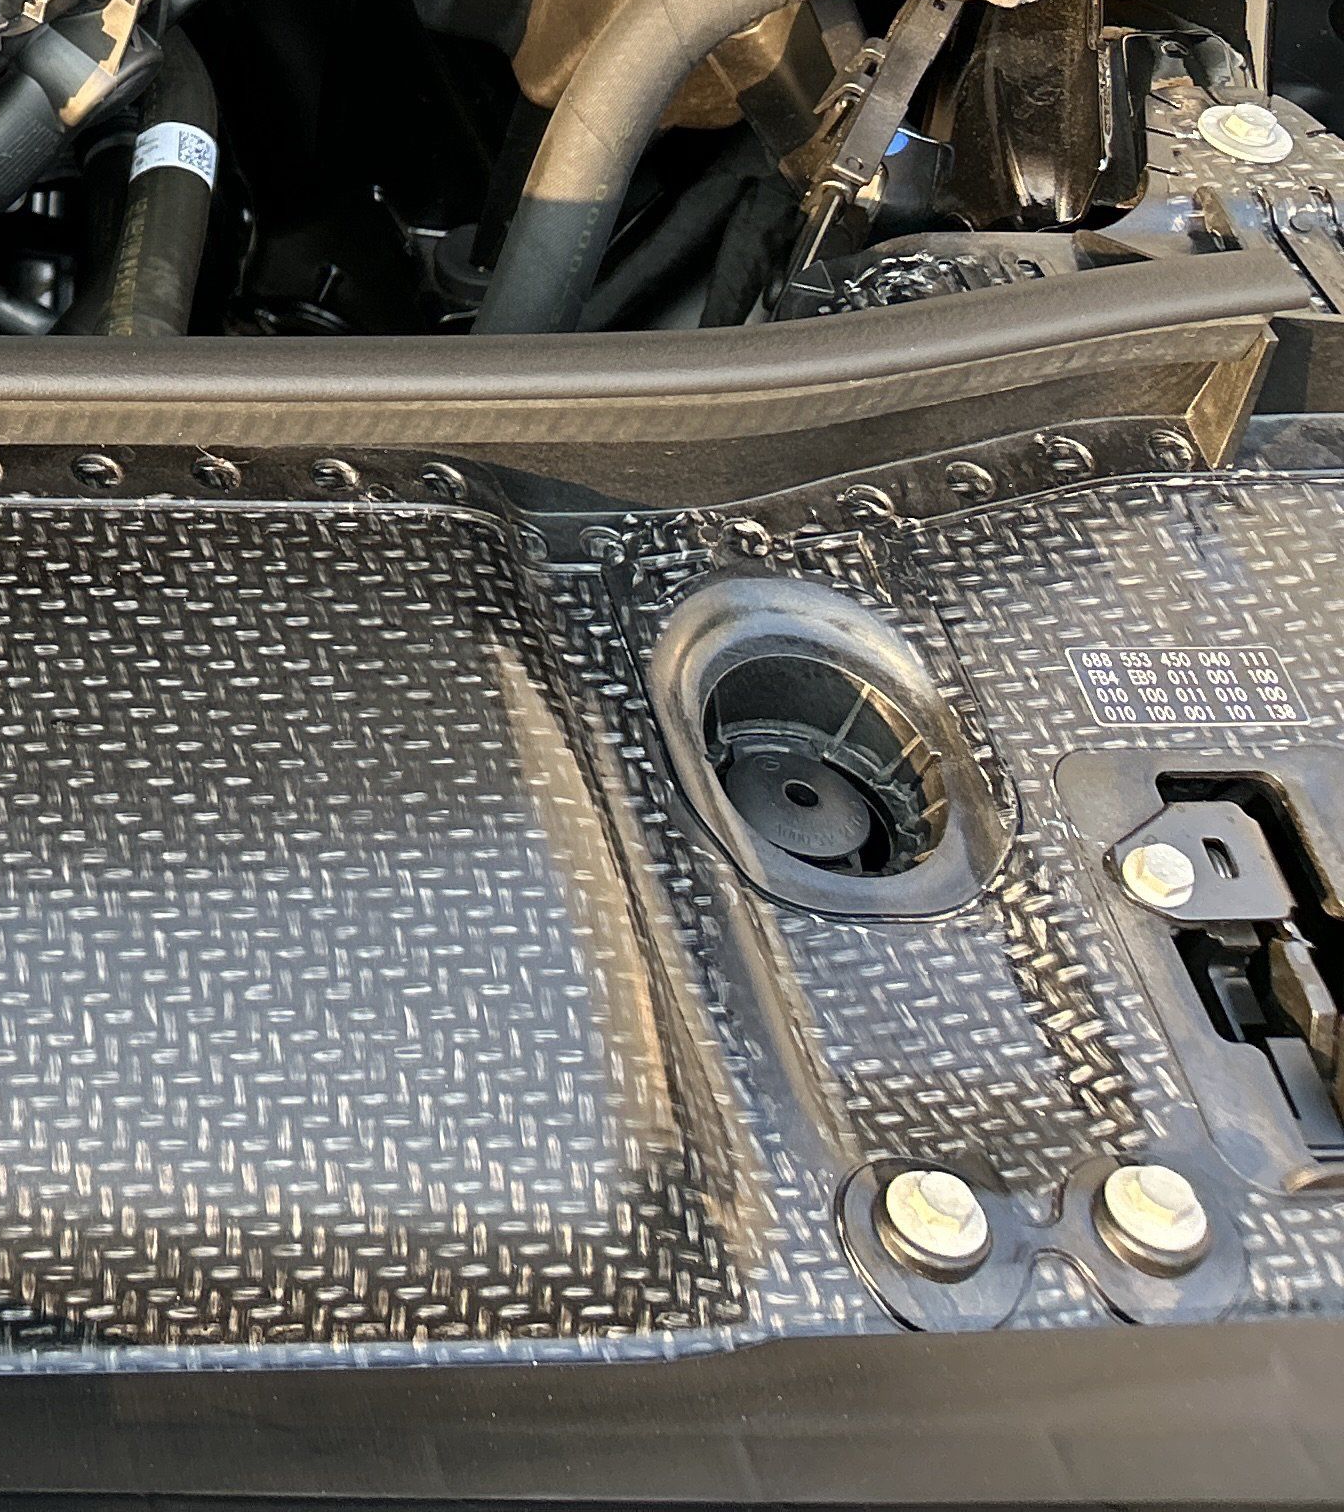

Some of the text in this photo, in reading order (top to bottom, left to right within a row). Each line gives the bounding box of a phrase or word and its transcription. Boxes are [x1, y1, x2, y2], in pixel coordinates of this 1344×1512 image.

[1082, 652, 1269, 668] 688 553 450 040 111
[1089, 670, 1278, 685] FB4 EB9 011 001 100
[1097, 687, 1287, 703] 010 100 011 010 100
[1105, 705, 1296, 721] 010 100 001 101 138
